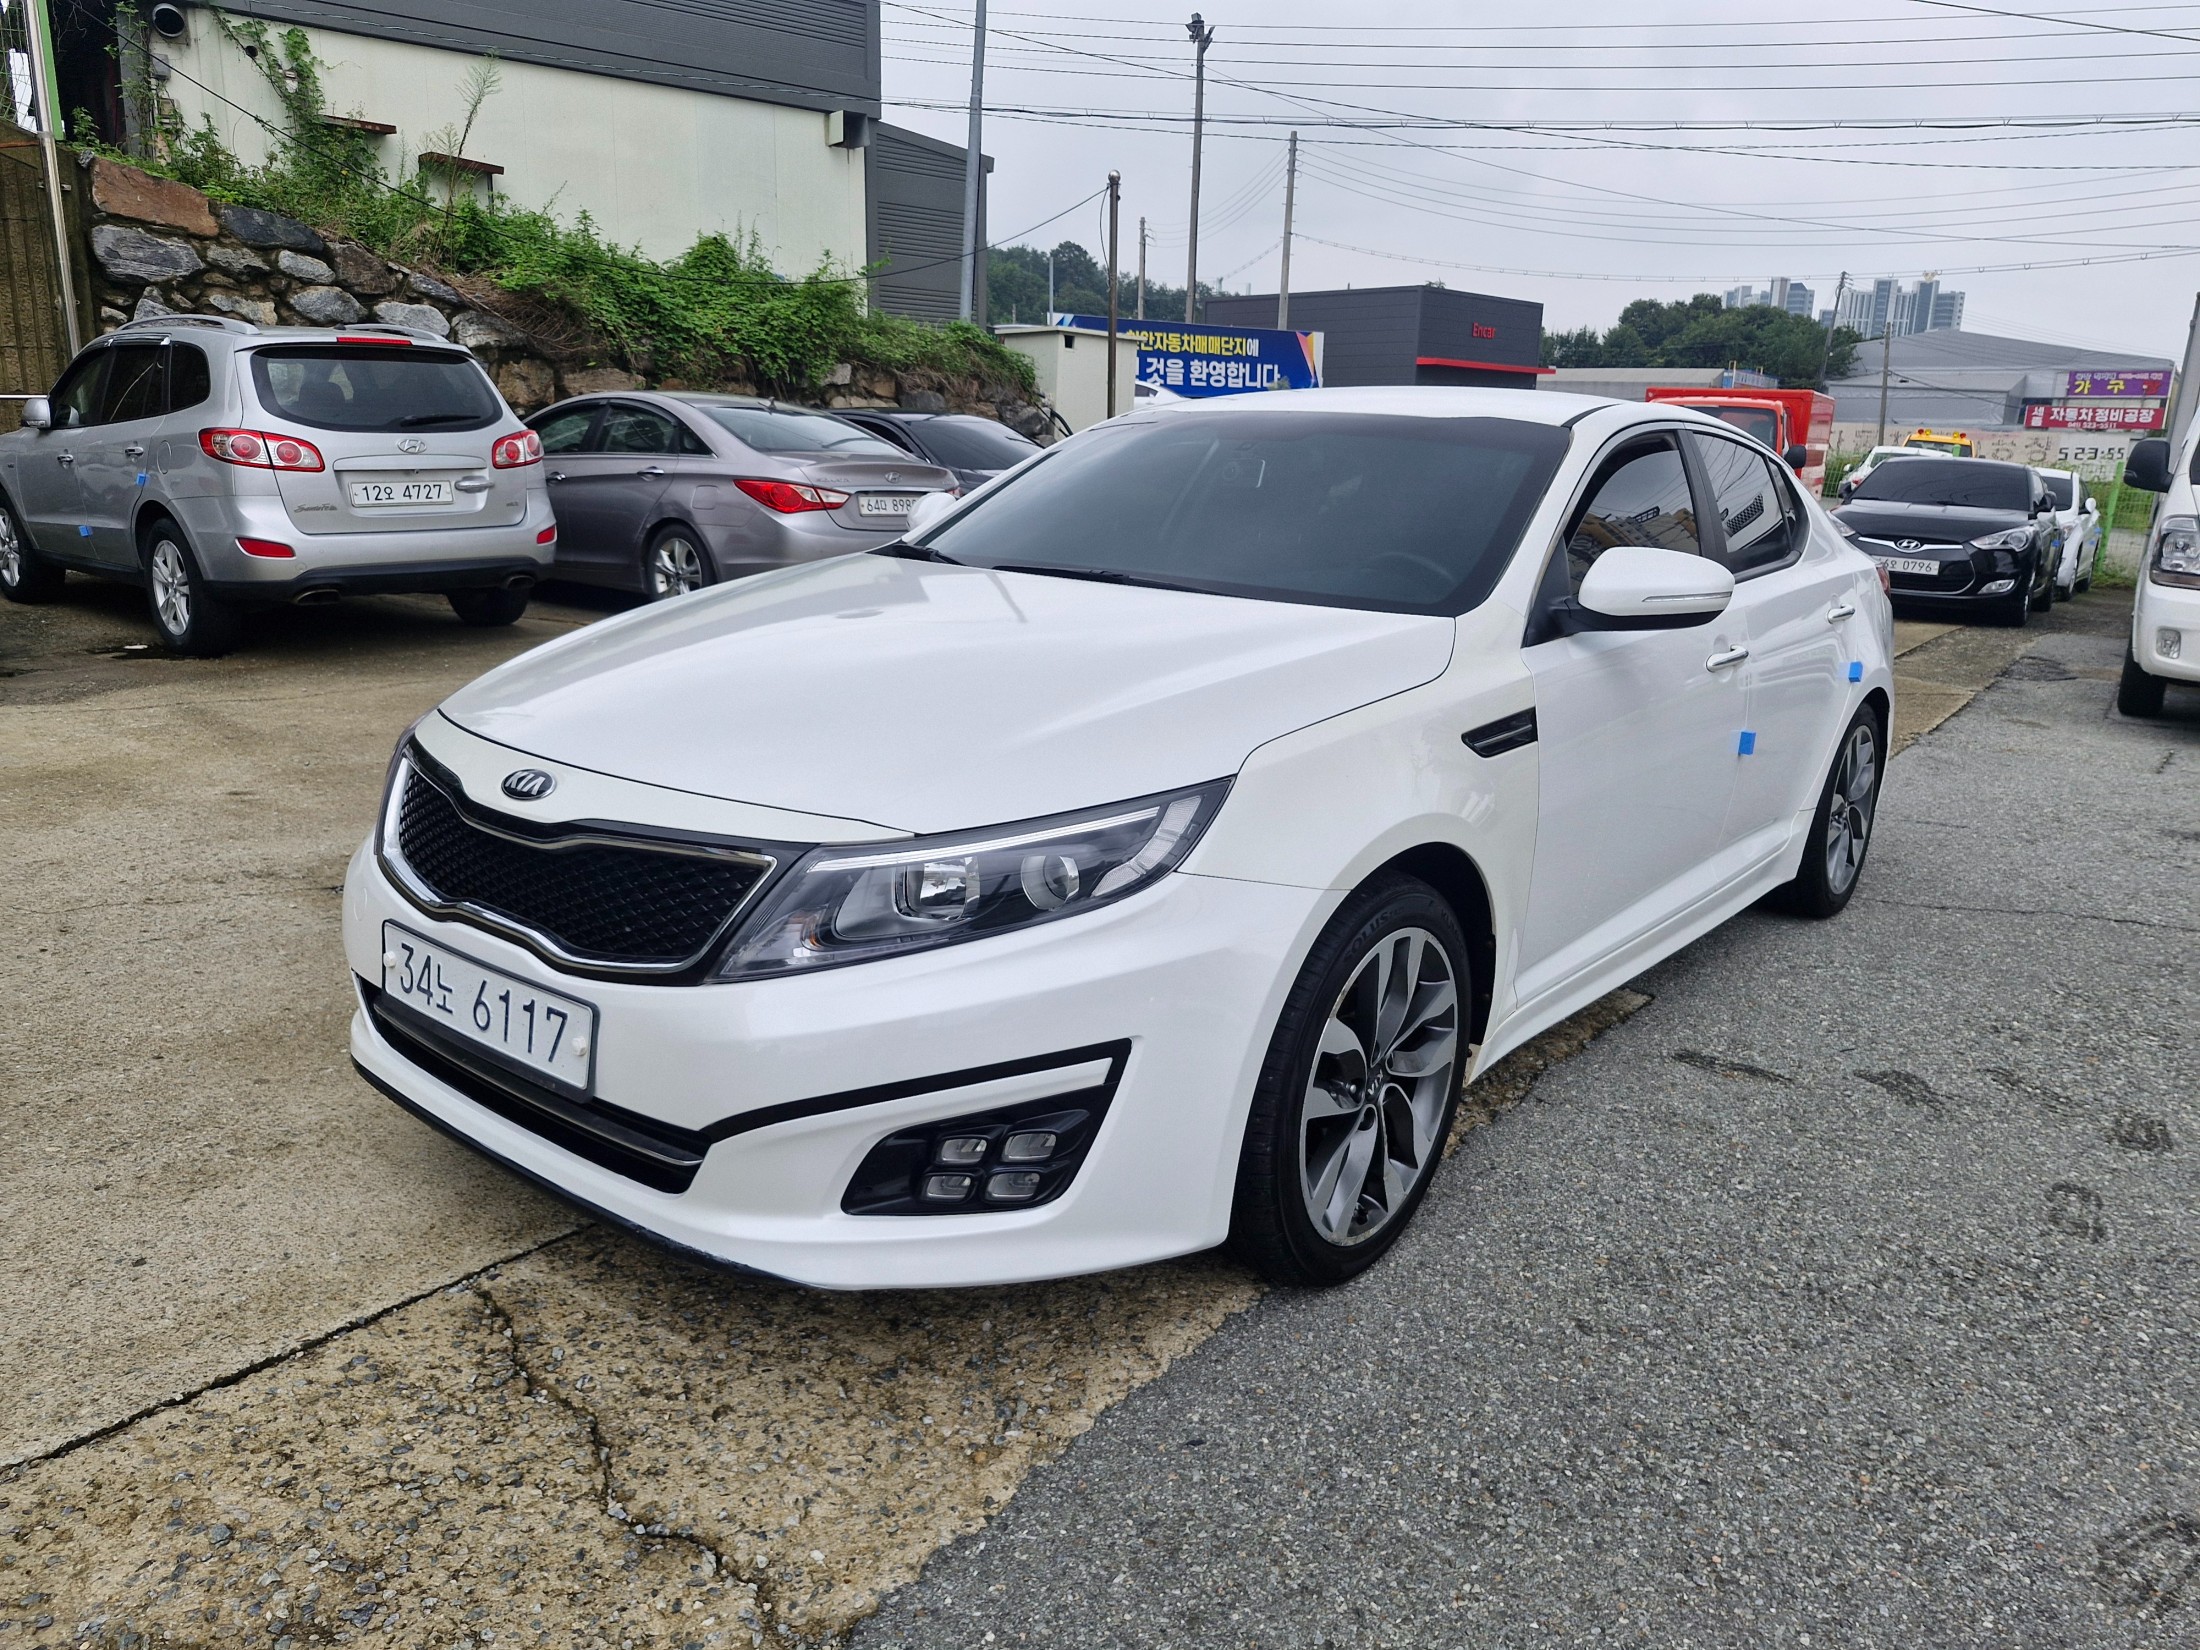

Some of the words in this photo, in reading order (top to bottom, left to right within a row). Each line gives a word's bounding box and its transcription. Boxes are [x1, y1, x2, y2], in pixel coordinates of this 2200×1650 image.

[1472, 321, 1496, 339] Encar
[1146, 357, 1185, 386] 것을
[1190, 359, 1281, 388] 환영합니다
[362, 485, 395, 501] 12오
[403, 484, 442, 500] 4727
[1879, 557, 1897, 569] 6오
[1903, 560, 1932, 573] 0796
[505, 771, 546, 796] KIA
[401, 943, 453, 1014] 34노
[473, 980, 568, 1062] 6117
